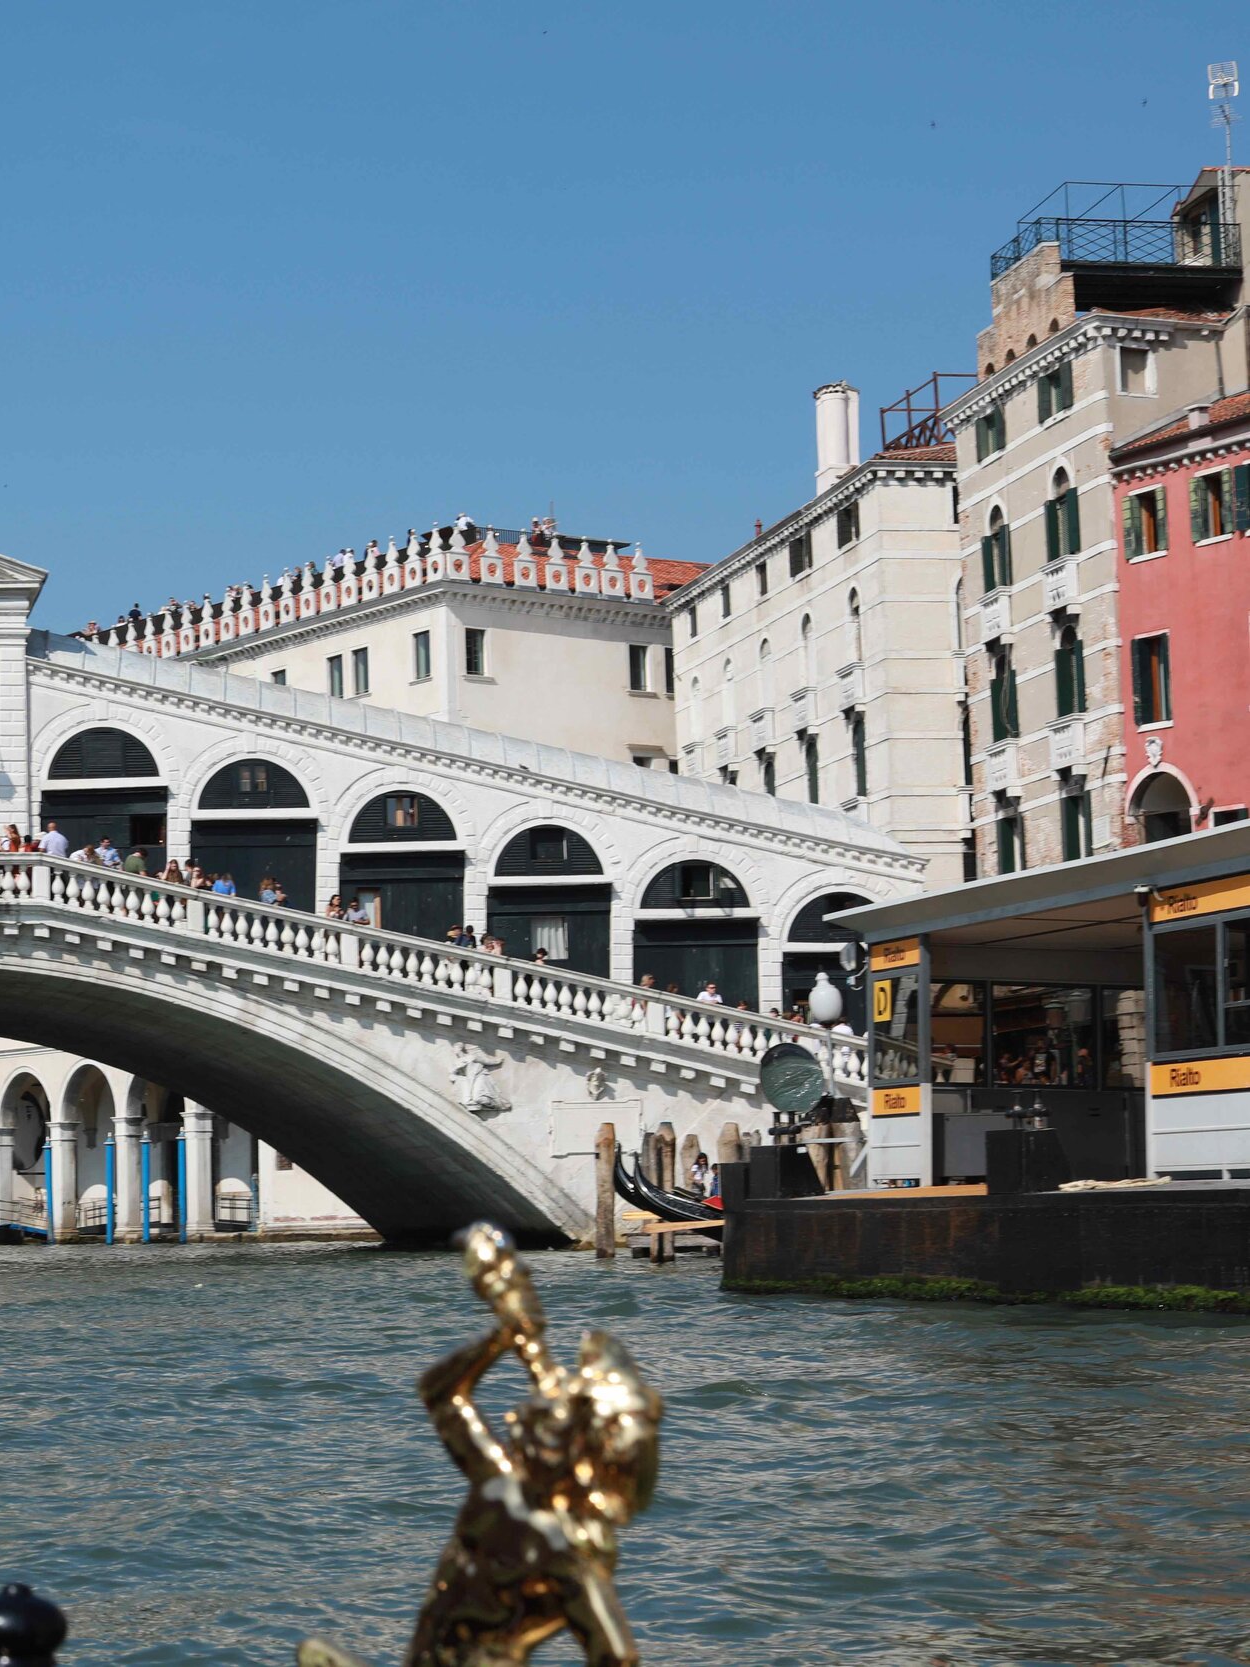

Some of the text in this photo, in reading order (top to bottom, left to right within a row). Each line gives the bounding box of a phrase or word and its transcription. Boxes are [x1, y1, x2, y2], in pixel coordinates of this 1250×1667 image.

[1167, 893, 1198, 914] Rialto
[877, 987, 888, 1015] D
[1170, 1067, 1201, 1087] Rialto
[884, 1093, 907, 1109] Rialto
